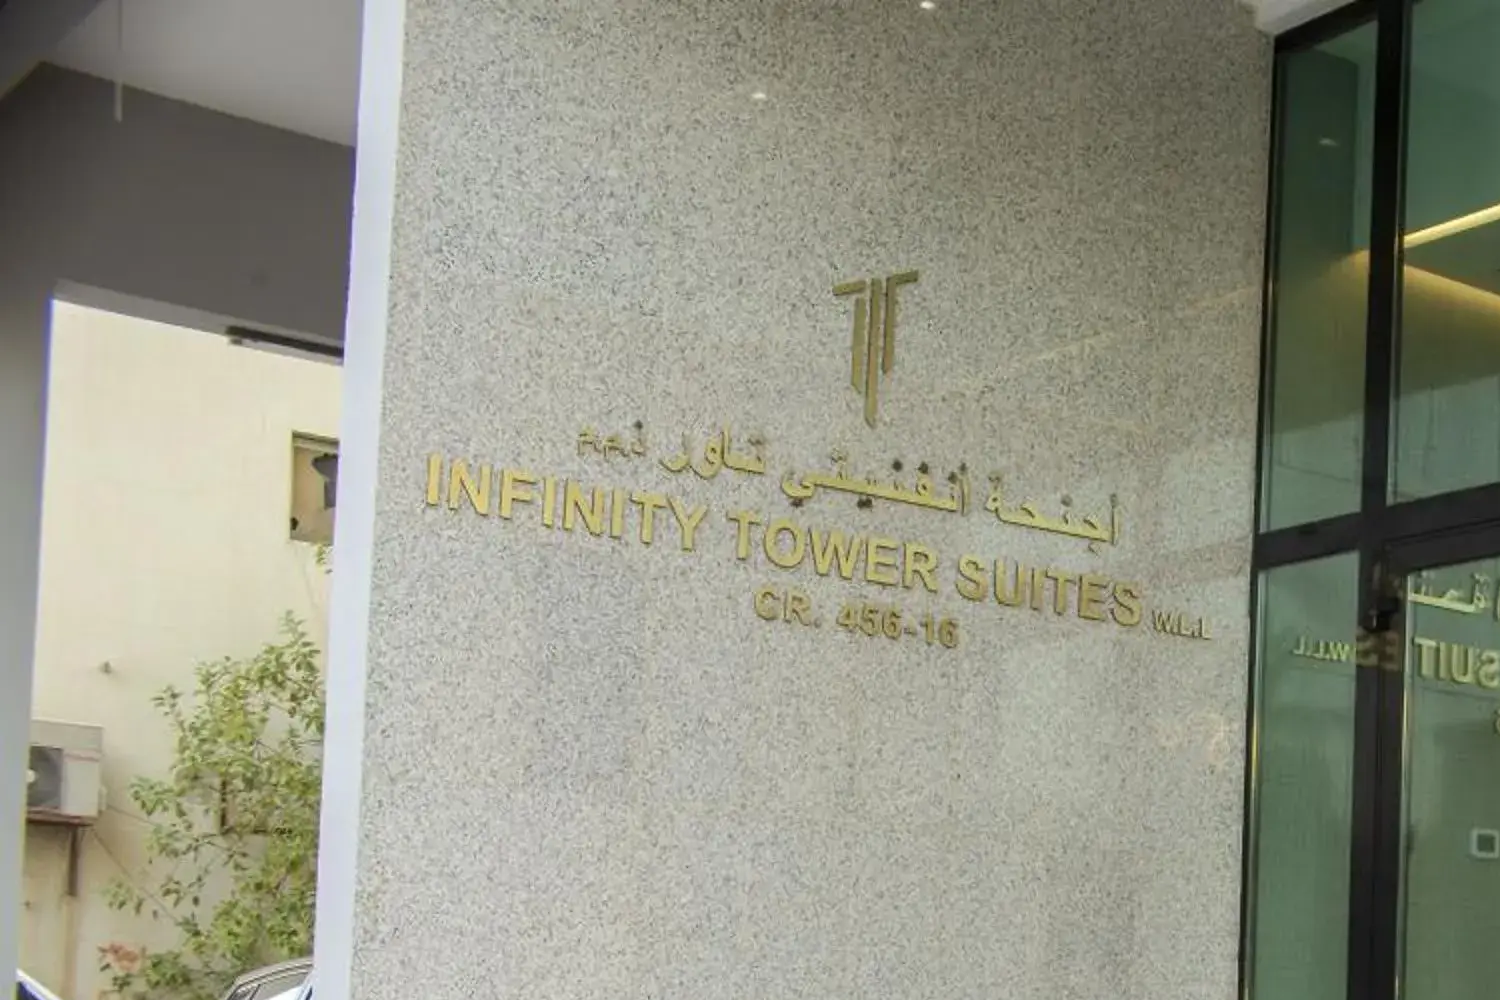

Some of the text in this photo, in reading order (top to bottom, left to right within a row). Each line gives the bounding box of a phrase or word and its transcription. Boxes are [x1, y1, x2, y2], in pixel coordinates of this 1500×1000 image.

[659, 420, 767, 480] تاور
[426, 451, 708, 553] INFINITY
[727, 508, 940, 594] TOWER
[954, 554, 1143, 627] SUITES
[836, 602, 960, 650] 456-16
